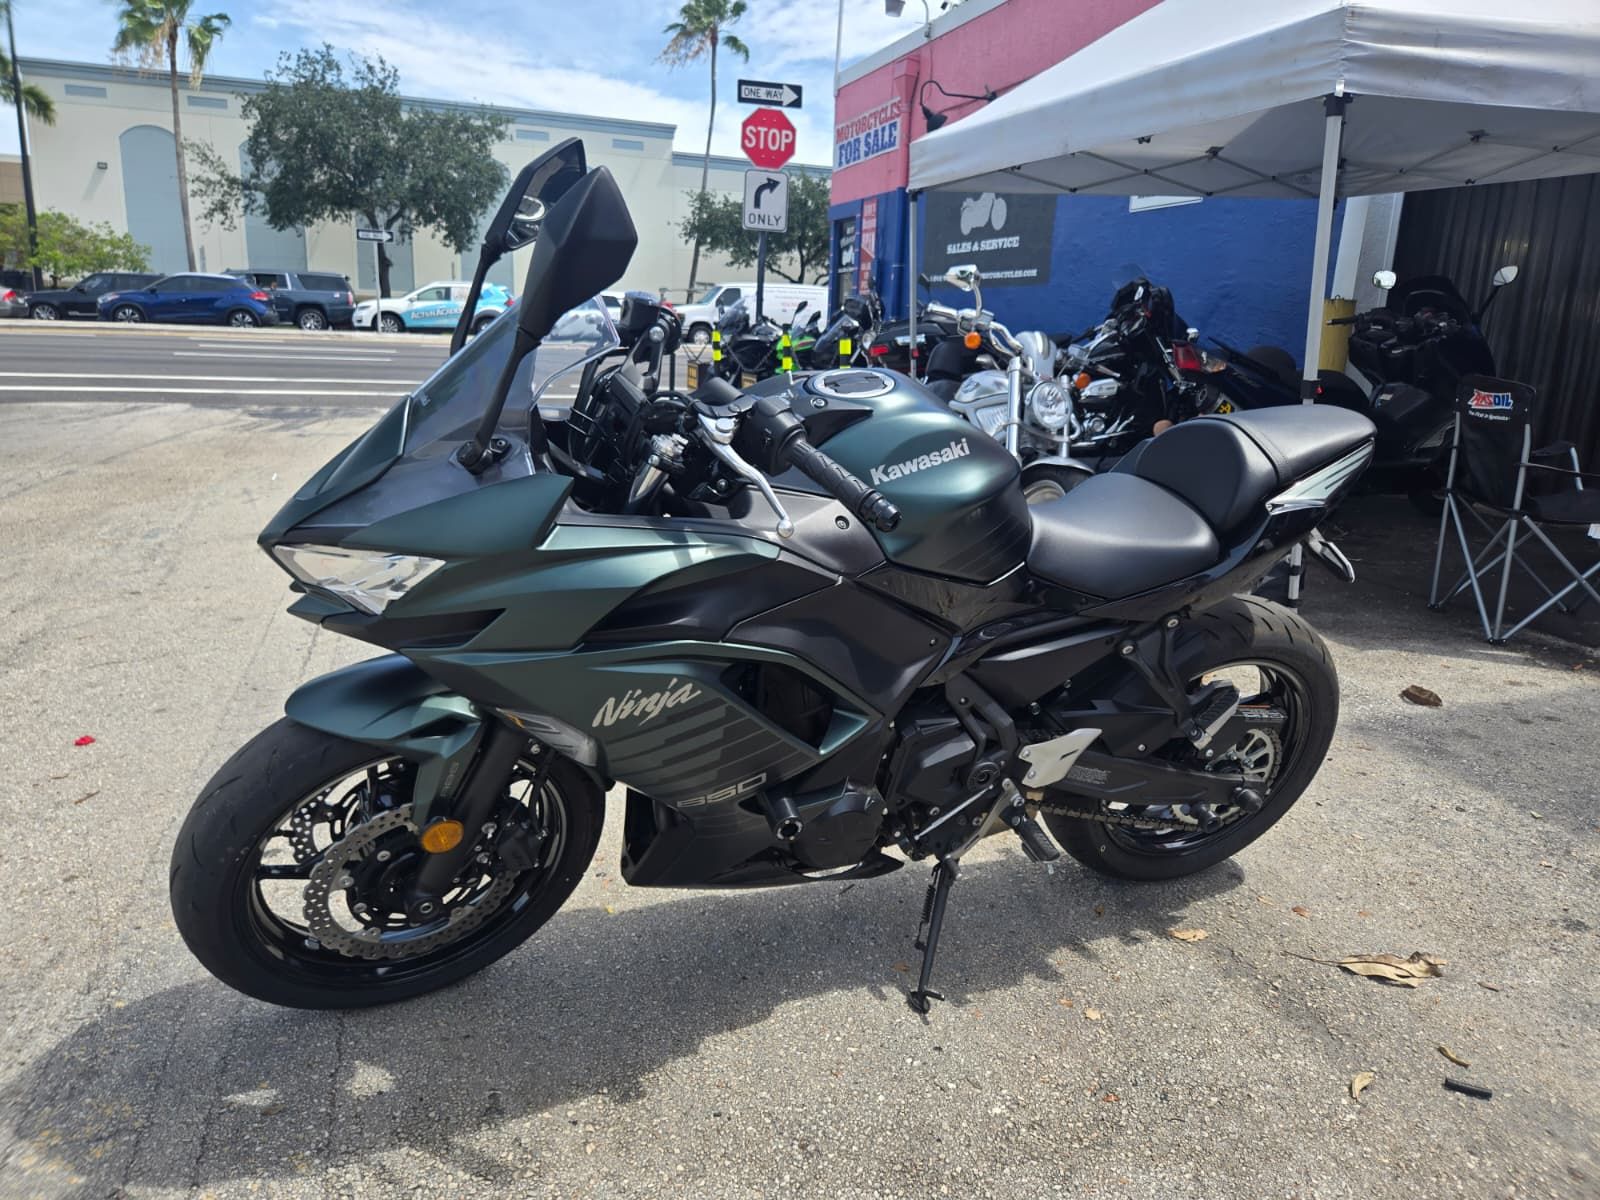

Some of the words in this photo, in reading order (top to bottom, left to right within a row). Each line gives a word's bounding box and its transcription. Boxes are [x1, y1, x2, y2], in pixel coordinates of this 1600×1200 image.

[744, 87, 761, 97] ONE
[765, 89, 784, 99] WAY
[744, 126, 793, 151] STOP
[836, 101, 901, 144] MOTORCYCLES
[838, 137, 861, 167] FOR
[864, 121, 897, 157] SALE
[749, 213, 781, 226] ONLY
[946, 242, 972, 254] SALES
[980, 236, 1020, 251] SERVICE
[870, 437, 971, 485] Kawasaki
[592, 677, 702, 727] Ninja
[676, 772, 767, 808] 650
